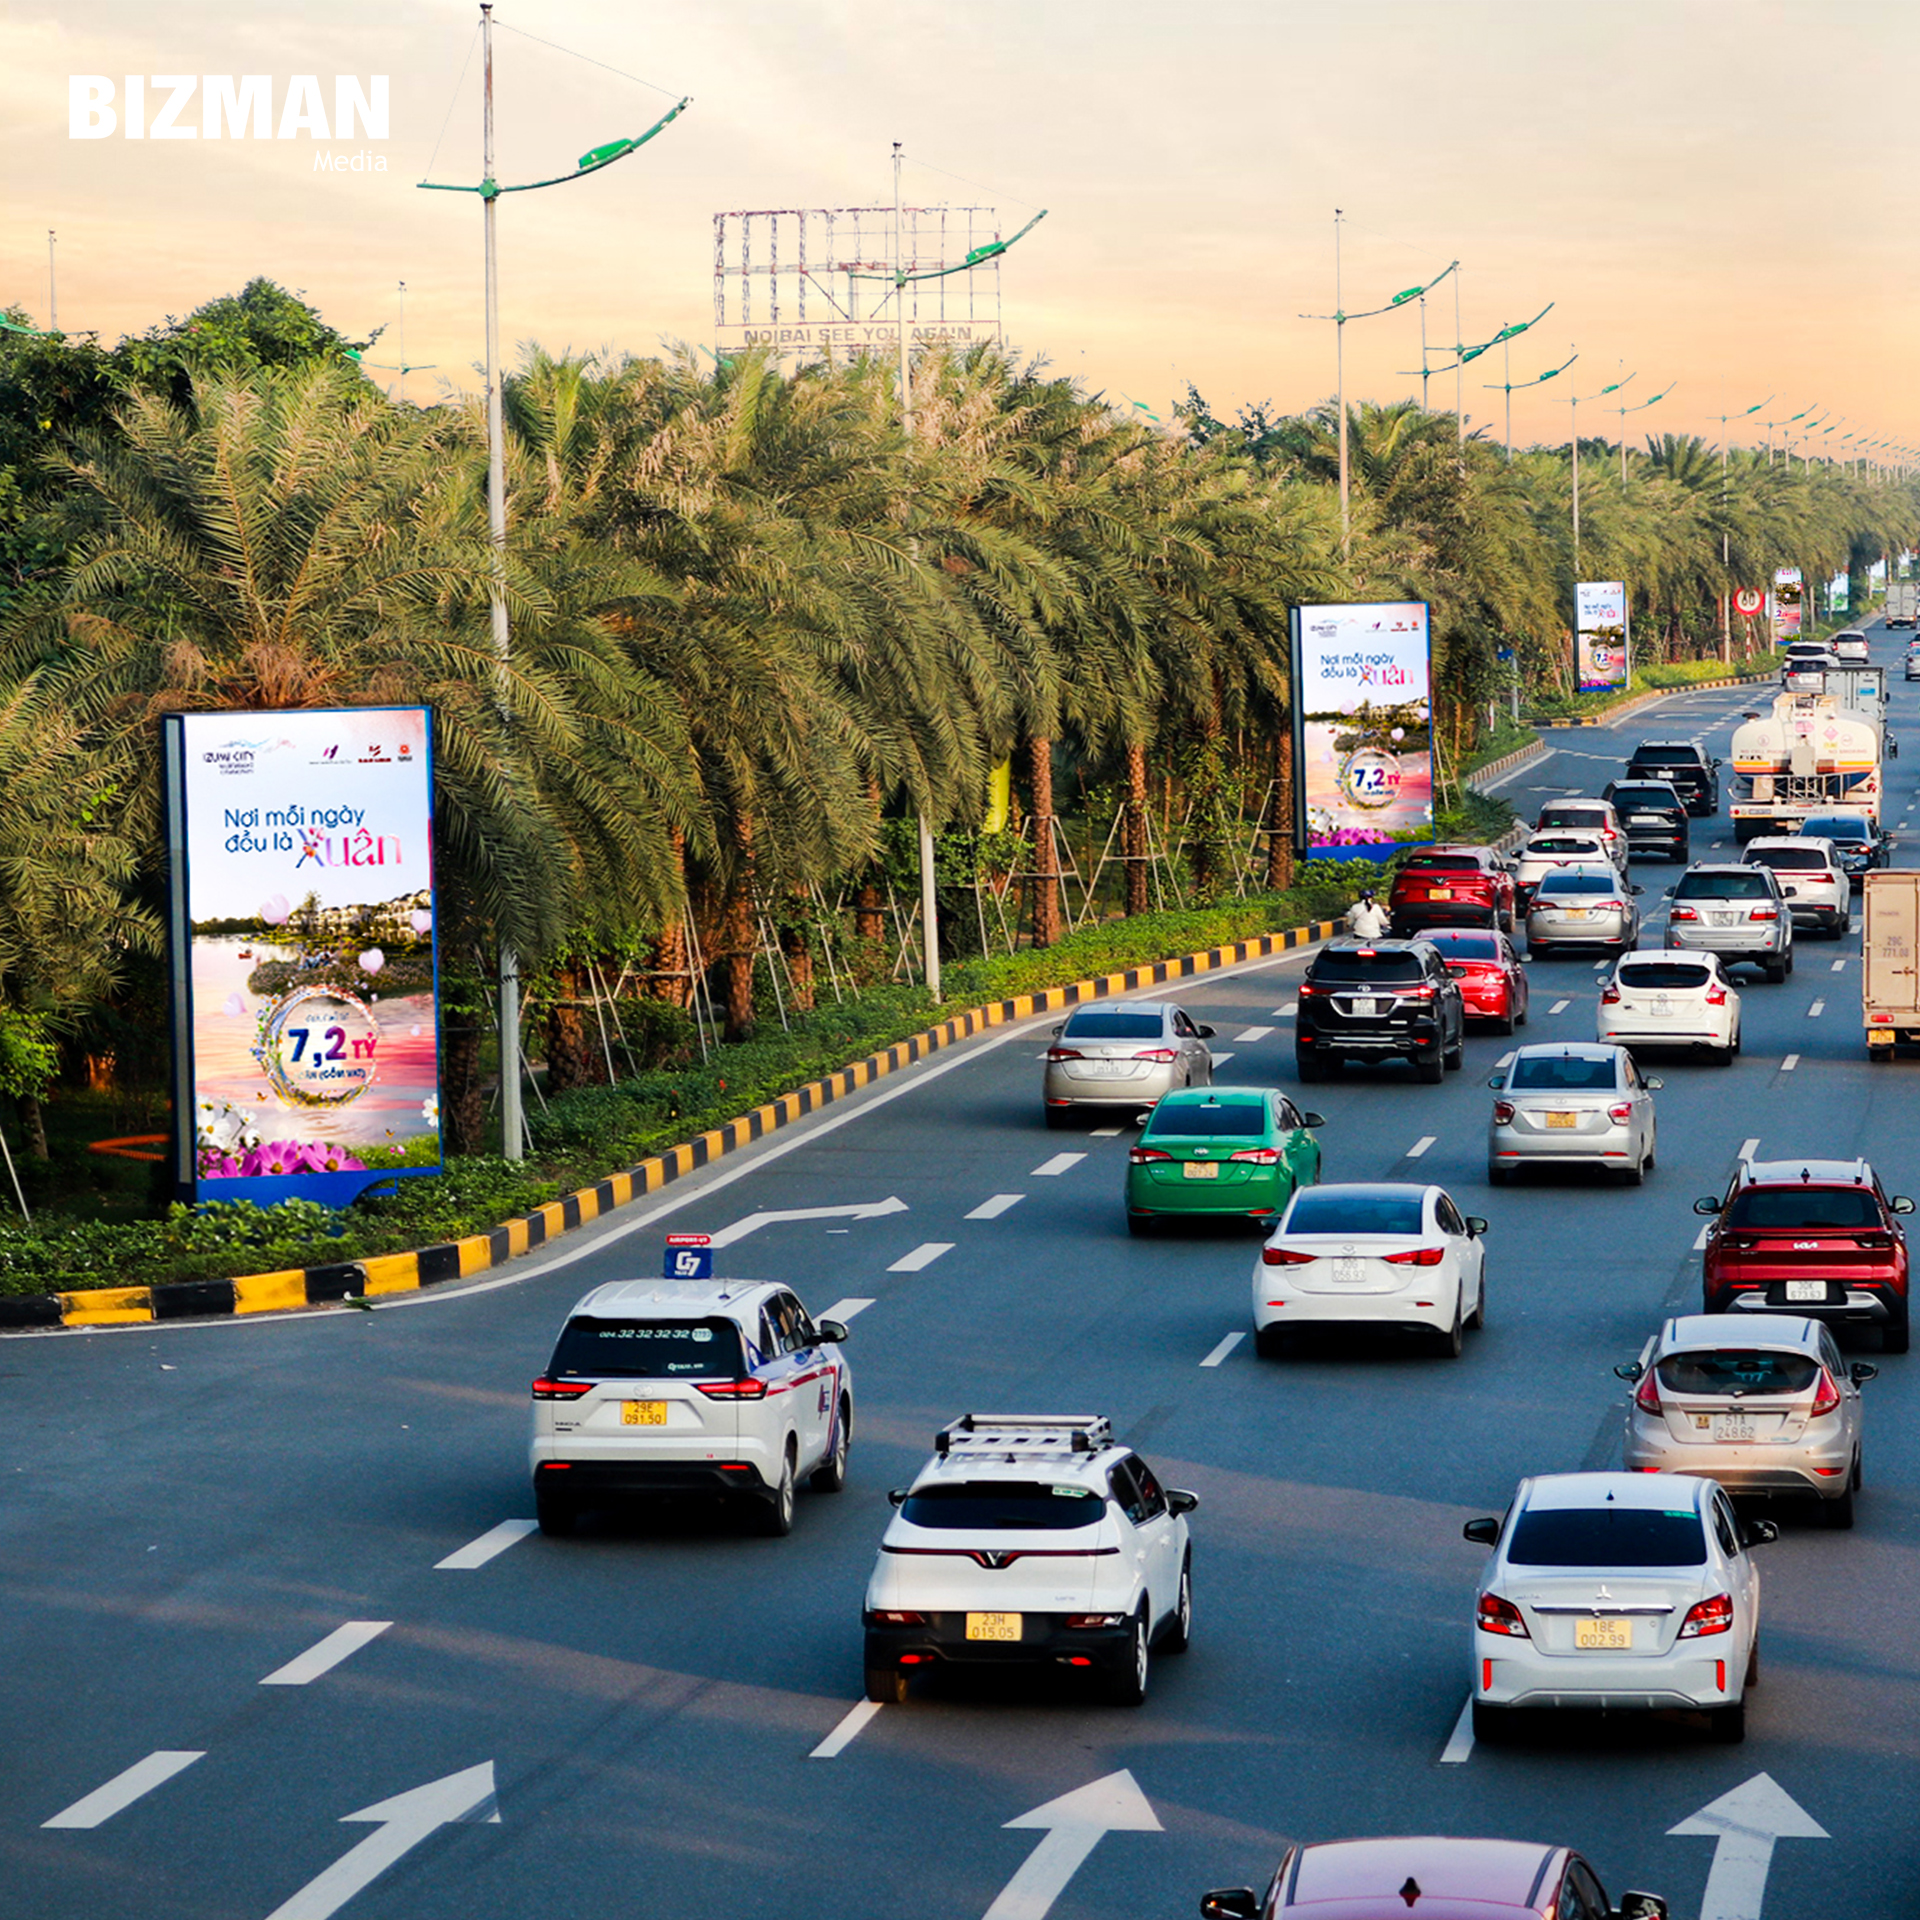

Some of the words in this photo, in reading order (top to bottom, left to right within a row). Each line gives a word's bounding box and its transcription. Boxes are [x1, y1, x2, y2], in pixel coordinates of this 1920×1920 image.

[819, 328, 855, 341] SEE
[1354, 768, 1385, 790] 7,2
[225, 808, 259, 828] Nơi
[266, 805, 305, 826] mỗi
[311, 805, 365, 828] ngày
[274, 831, 292, 851] là
[295, 827, 402, 868] Xuân
[288, 1025, 347, 1067] 7,2
[351, 1032, 377, 1059] TỶ
[676, 1251, 701, 1276] G7
[635, 1329, 653, 1339] 32
[654, 1329, 671, 1339] 32
[672, 1329, 690, 1339] 32
[634, 1402, 653, 1413] 29E
[625, 1414, 661, 1425] 091.50
[1725, 1414, 1747, 1426] 51A
[1717, 1427, 1754, 1439] 248.62
[982, 1614, 1005, 1625] 23H
[972, 1627, 1014, 1638] 015.05
[1592, 1621, 1615, 1633] 18E
[1581, 1634, 1625, 1646] 002.99
